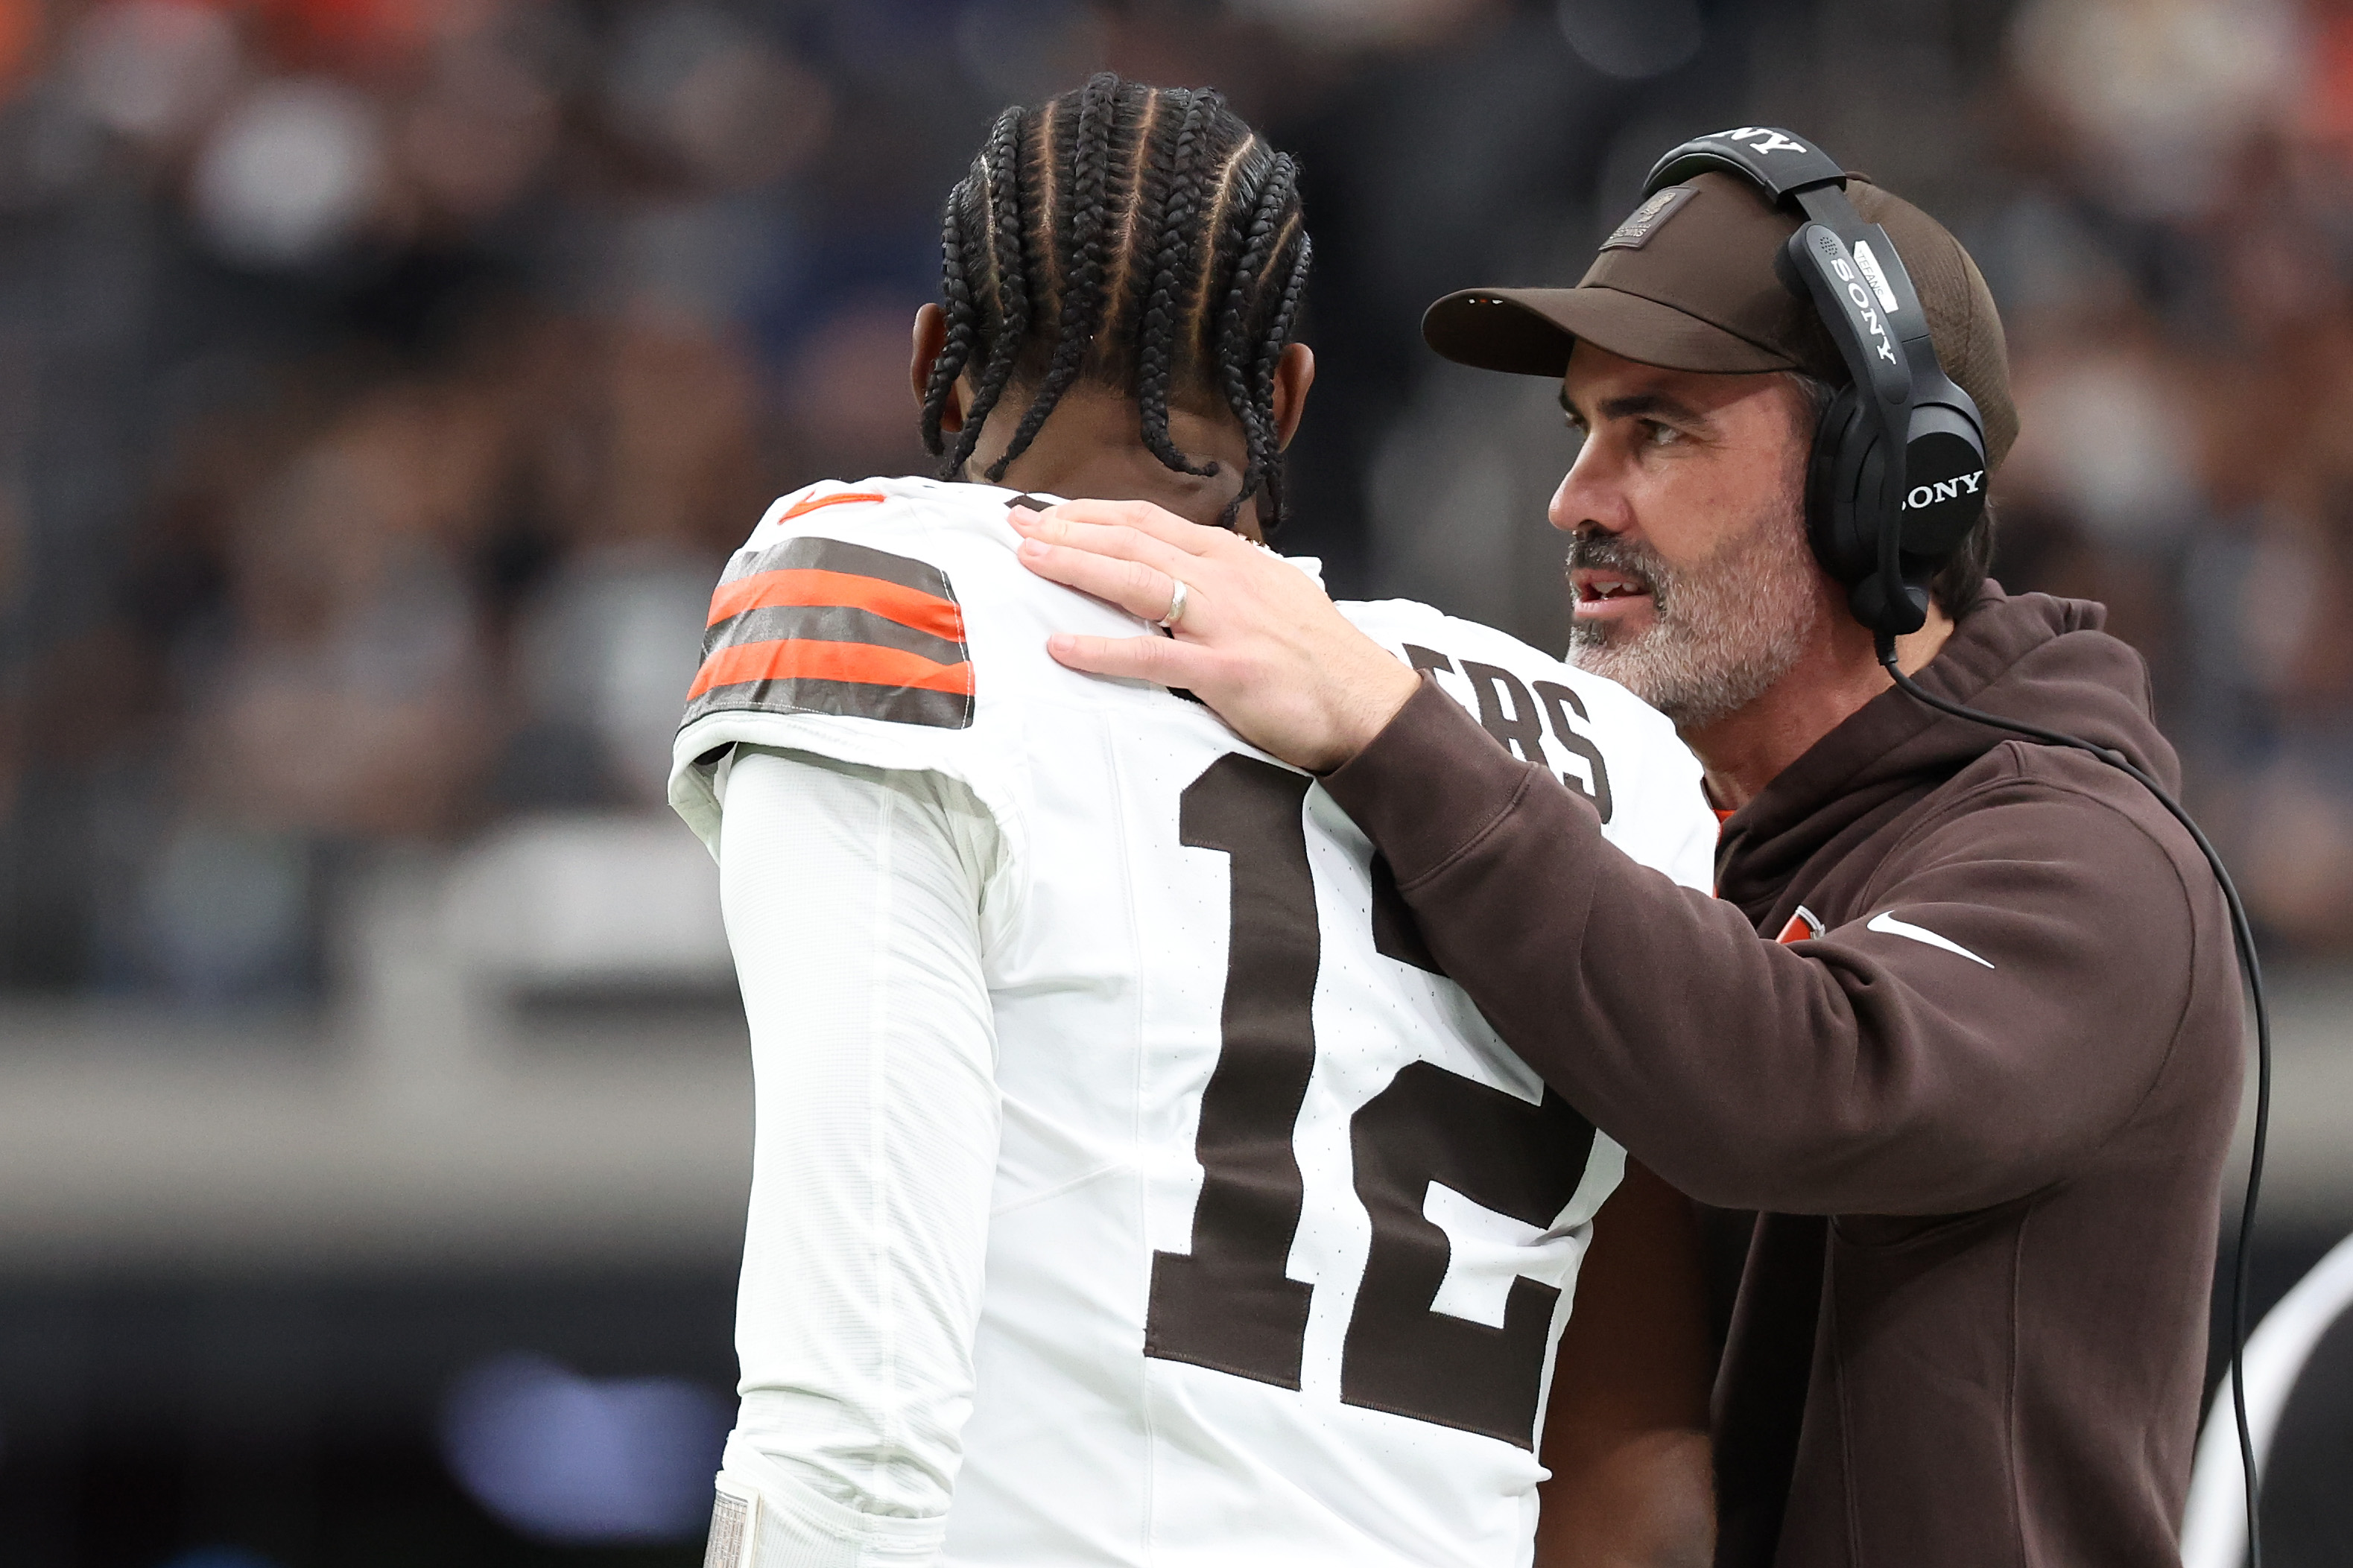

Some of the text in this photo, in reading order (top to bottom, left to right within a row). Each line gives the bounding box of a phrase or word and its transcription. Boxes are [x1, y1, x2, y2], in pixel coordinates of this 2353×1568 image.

[1708, 127, 1807, 154] NY
[1830, 258, 1897, 365] SONY
[1901, 470, 1983, 511] ONY
[1144, 751, 1597, 1453] 12
